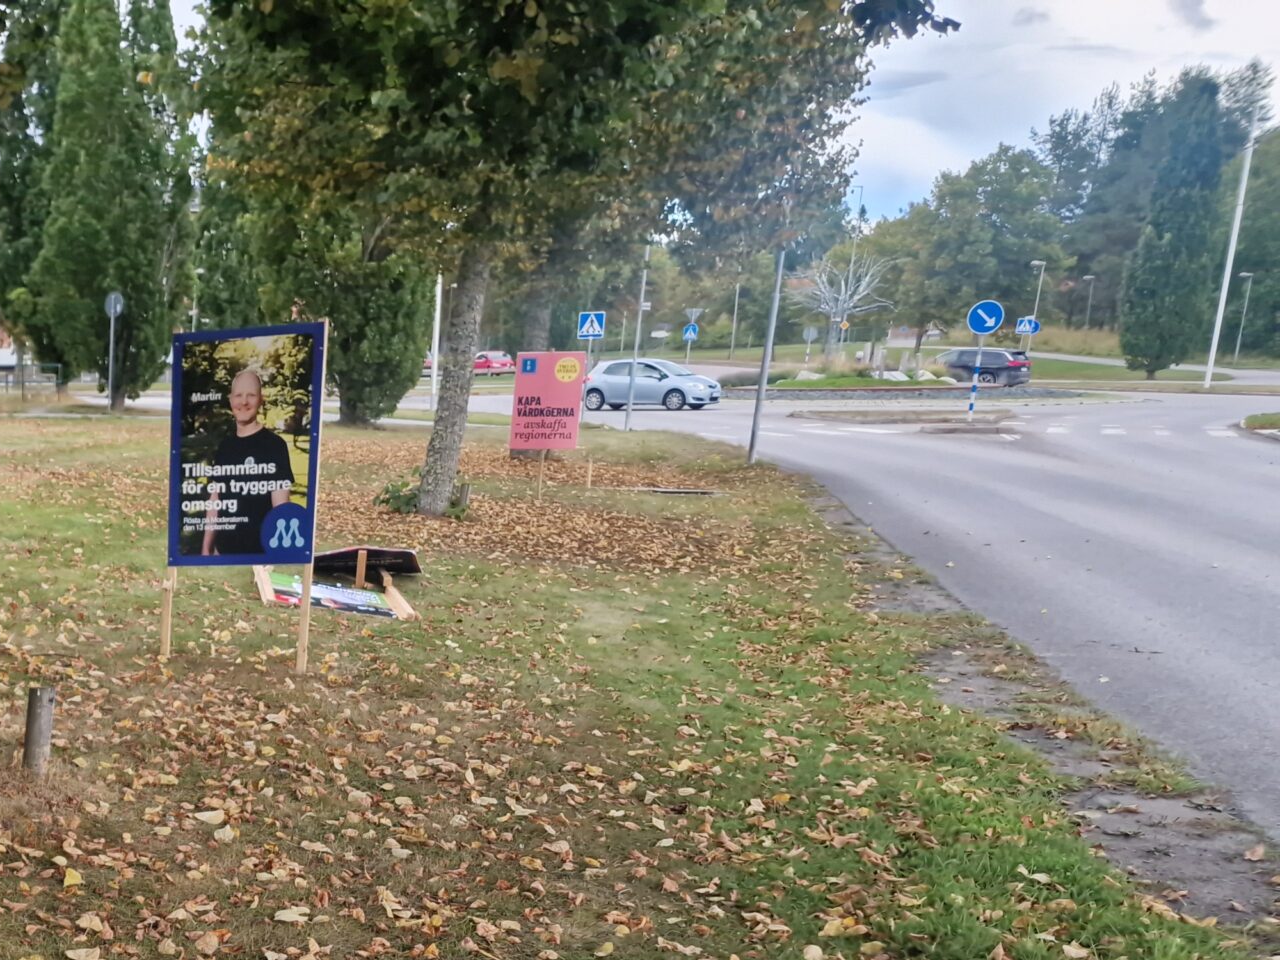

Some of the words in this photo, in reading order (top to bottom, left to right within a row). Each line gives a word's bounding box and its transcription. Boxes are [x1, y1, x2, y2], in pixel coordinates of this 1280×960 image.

[191, 389, 222, 403] Martin
[517, 396, 541, 406] KAPA
[517, 405, 575, 417] VÅRDKÖERNA
[523, 418, 567, 432] avskaffa
[514, 430, 572, 442] regionerna
[182, 462, 276, 477] Tillsammans
[181, 481, 203, 495] för
[207, 482, 226, 494] en
[230, 479, 292, 495] tryggare
[181, 499, 238, 513] omsorg
